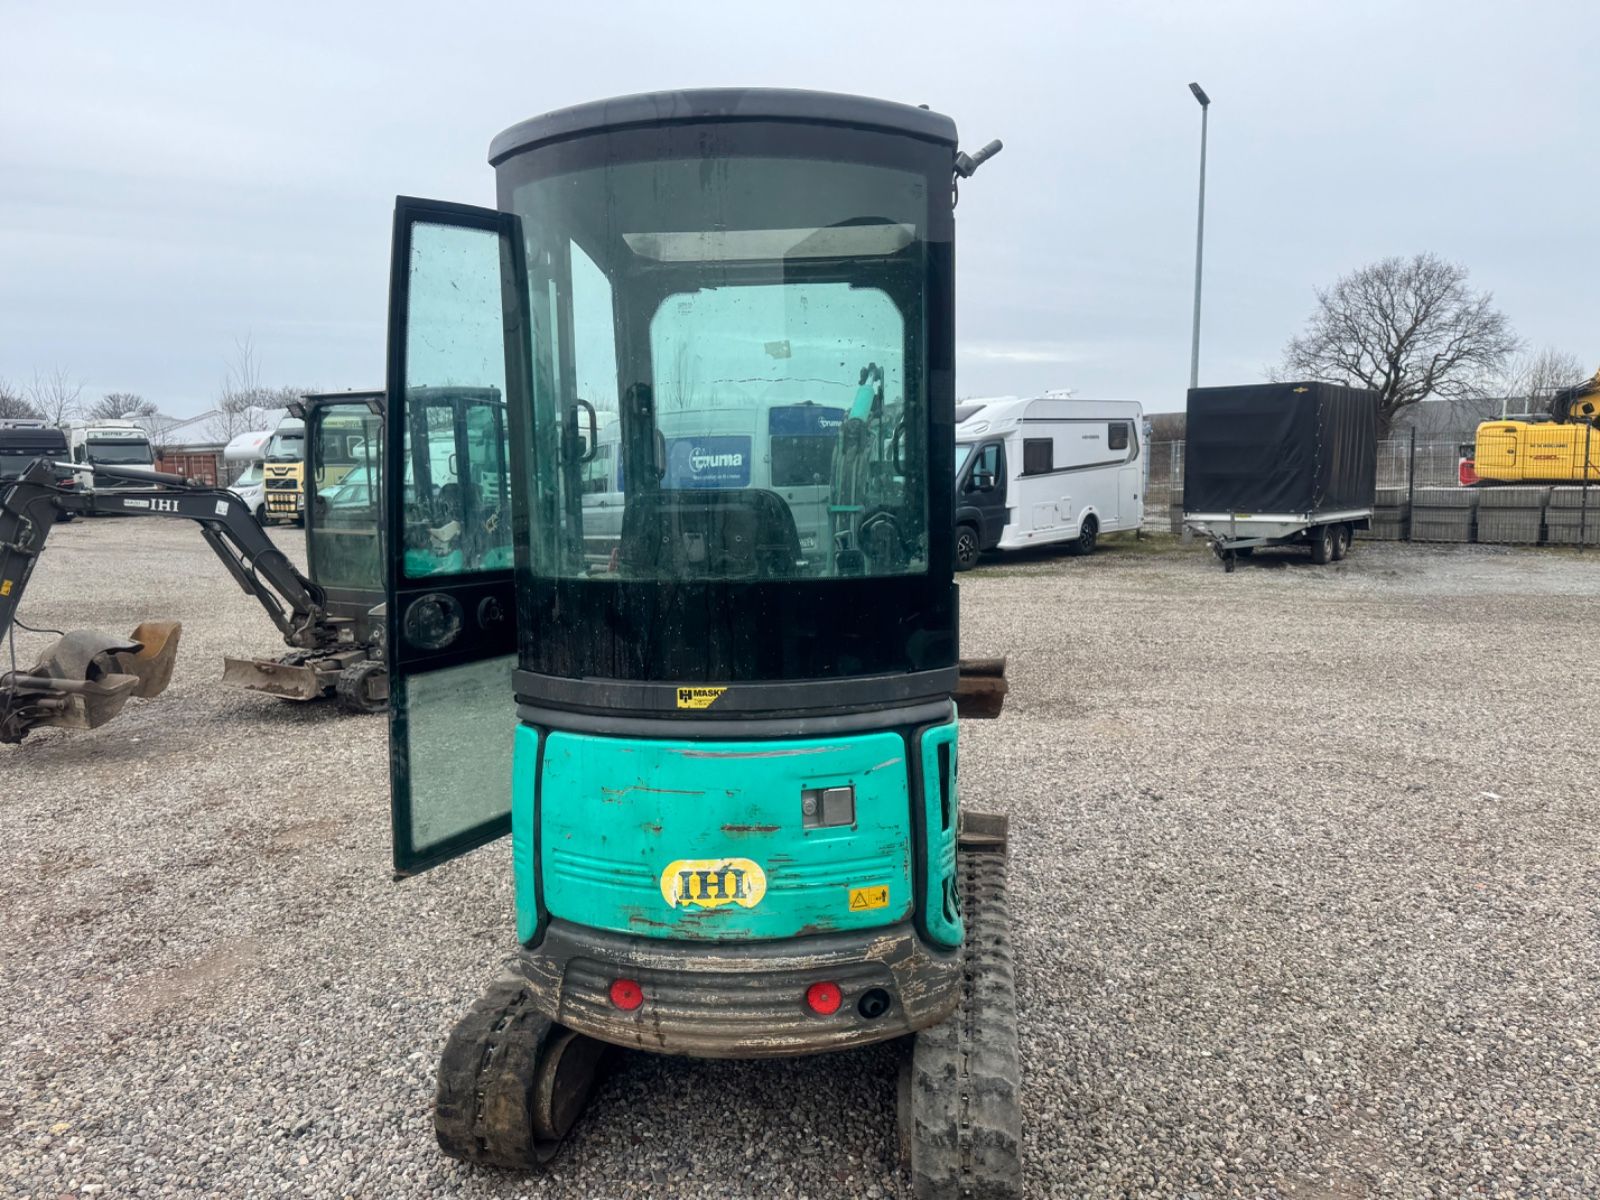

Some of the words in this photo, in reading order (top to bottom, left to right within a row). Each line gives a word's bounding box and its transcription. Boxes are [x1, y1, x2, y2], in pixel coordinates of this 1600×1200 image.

[691, 448, 742, 470] truma
[150, 498, 179, 512] IHI
[679, 868, 747, 900] IHI
